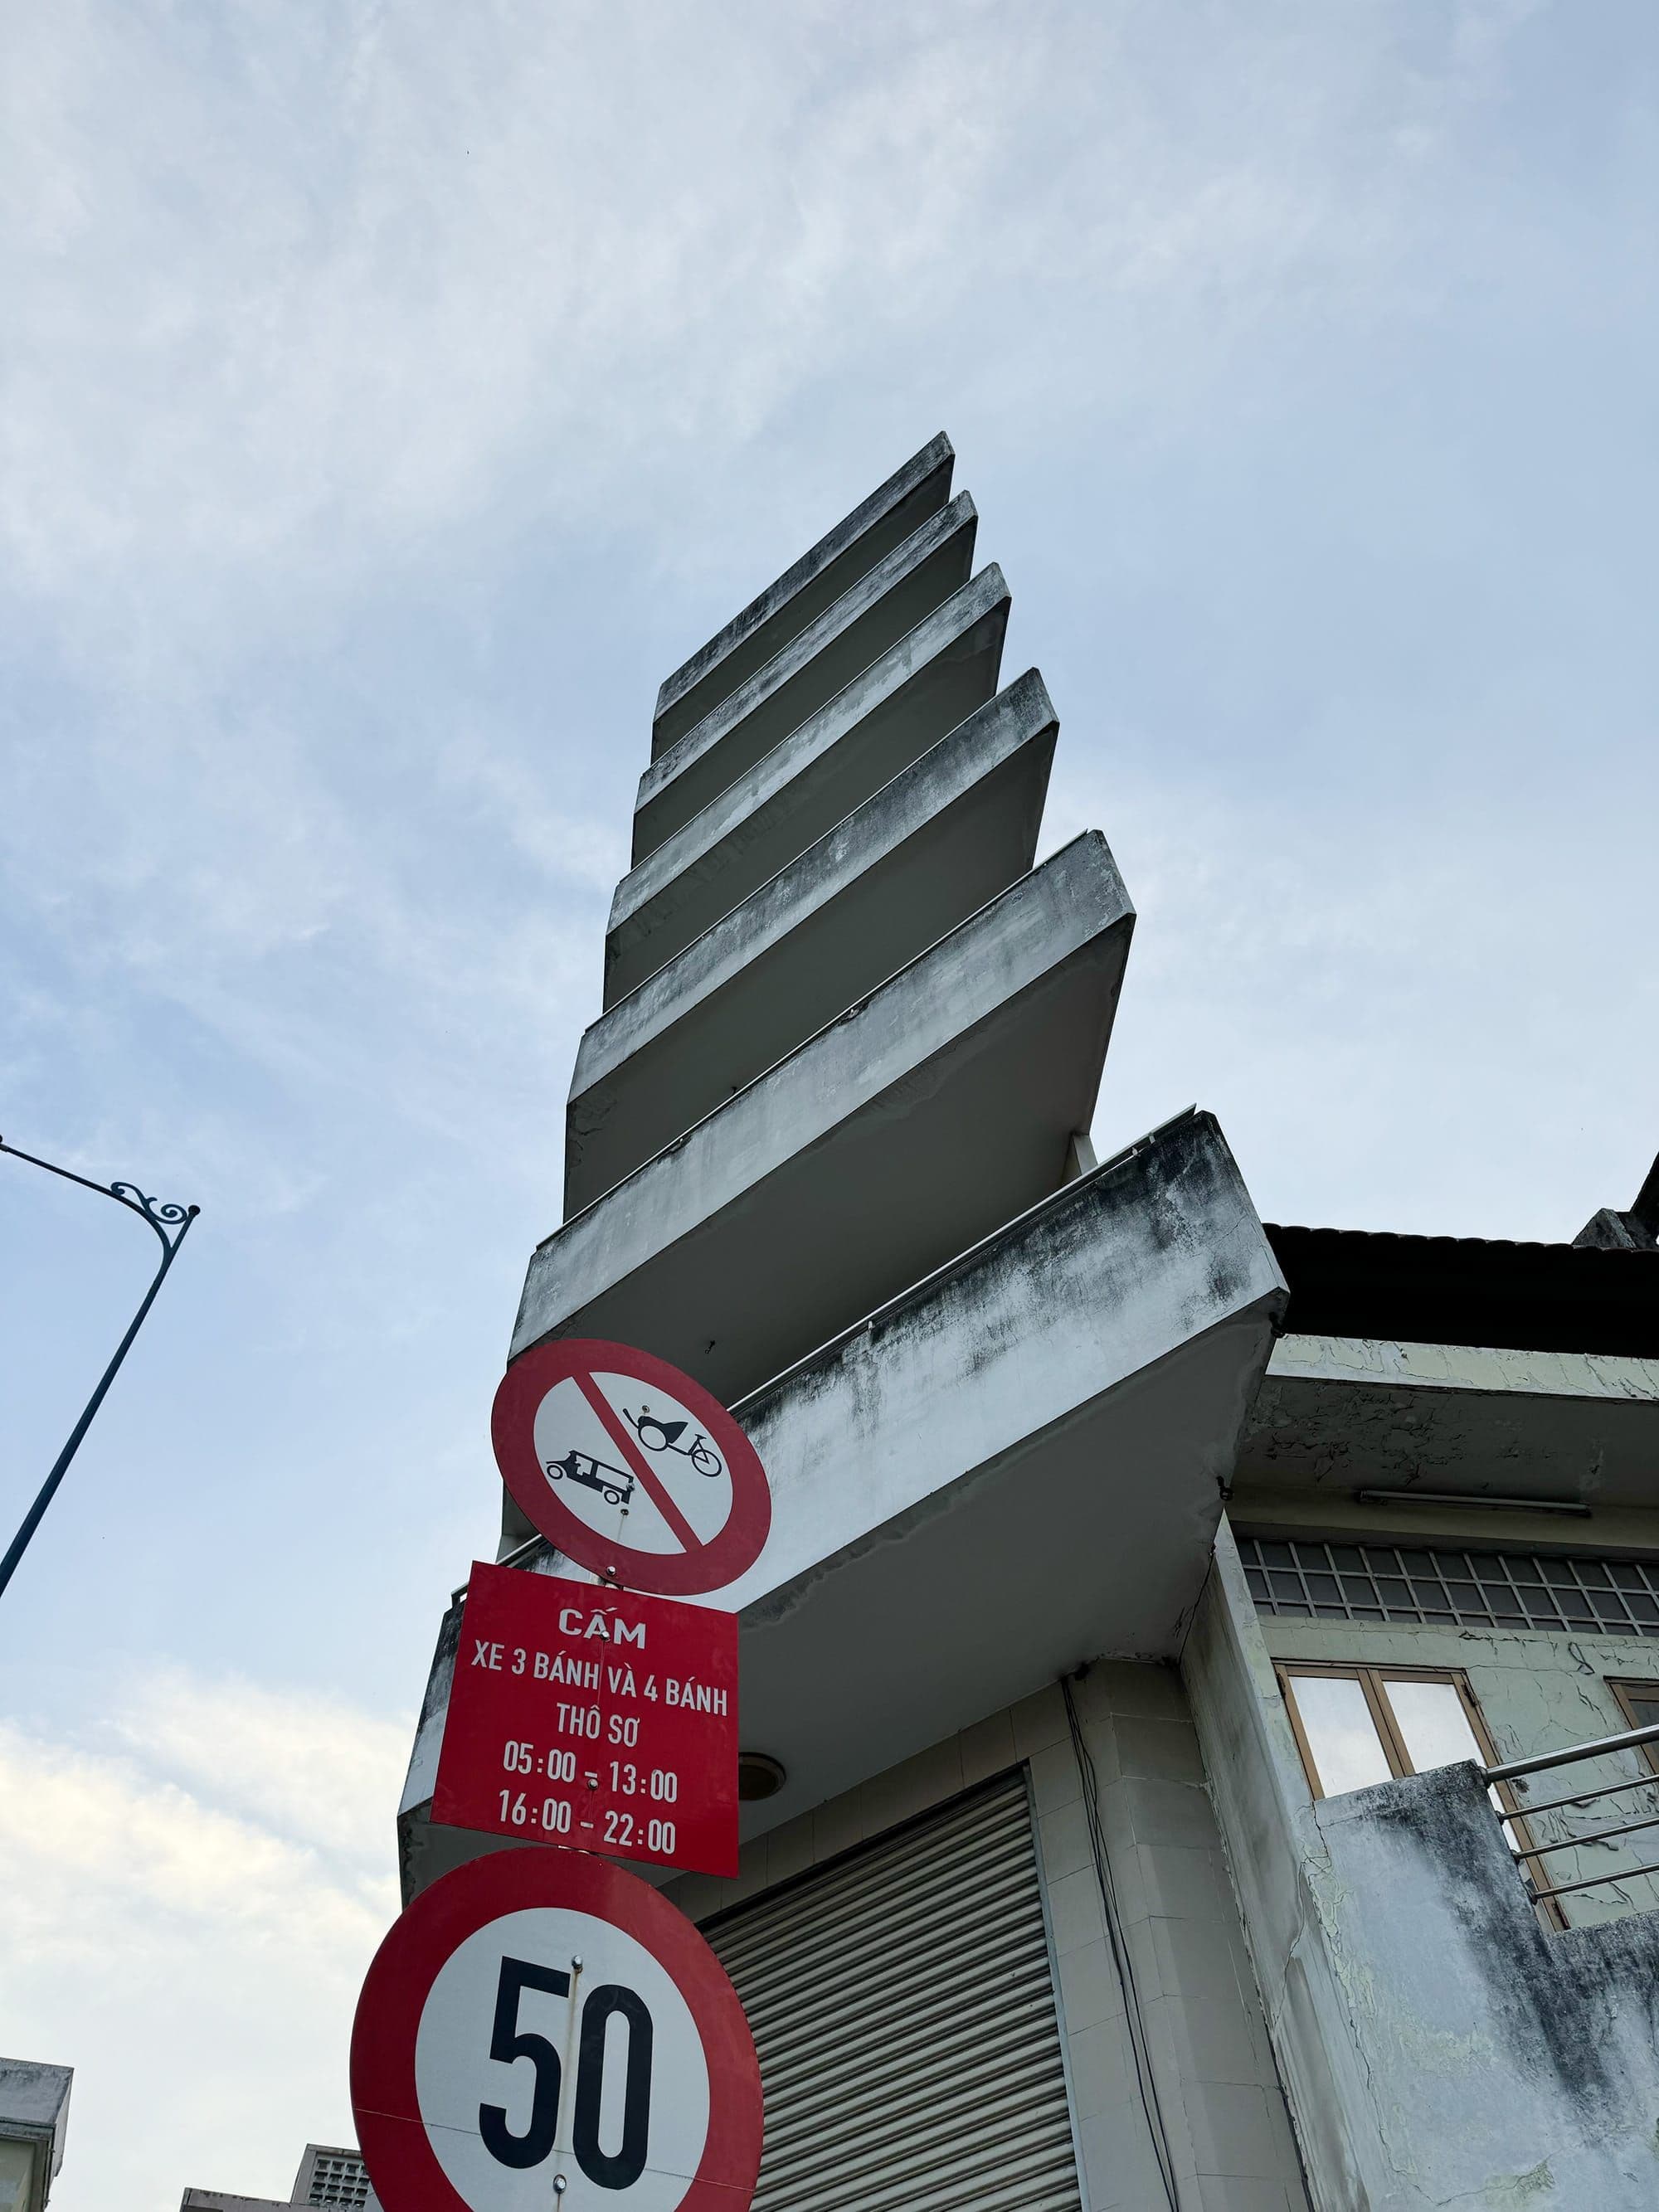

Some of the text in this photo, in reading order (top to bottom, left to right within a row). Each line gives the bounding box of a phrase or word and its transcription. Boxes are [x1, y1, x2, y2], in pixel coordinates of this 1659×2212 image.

[559, 1607, 646, 1649] CẤM
[471, 1640, 727, 1716] XE 3 BÁNH VÀ 4 BÁNH
[557, 1703, 640, 1748] THÔ SƠ
[504, 1740, 577, 1782] 05:00
[610, 1761, 678, 1803] 13:00
[499, 1789, 572, 1833] 16:00
[603, 1811, 676, 1855] 22:00
[479, 1956, 654, 2190] 50
